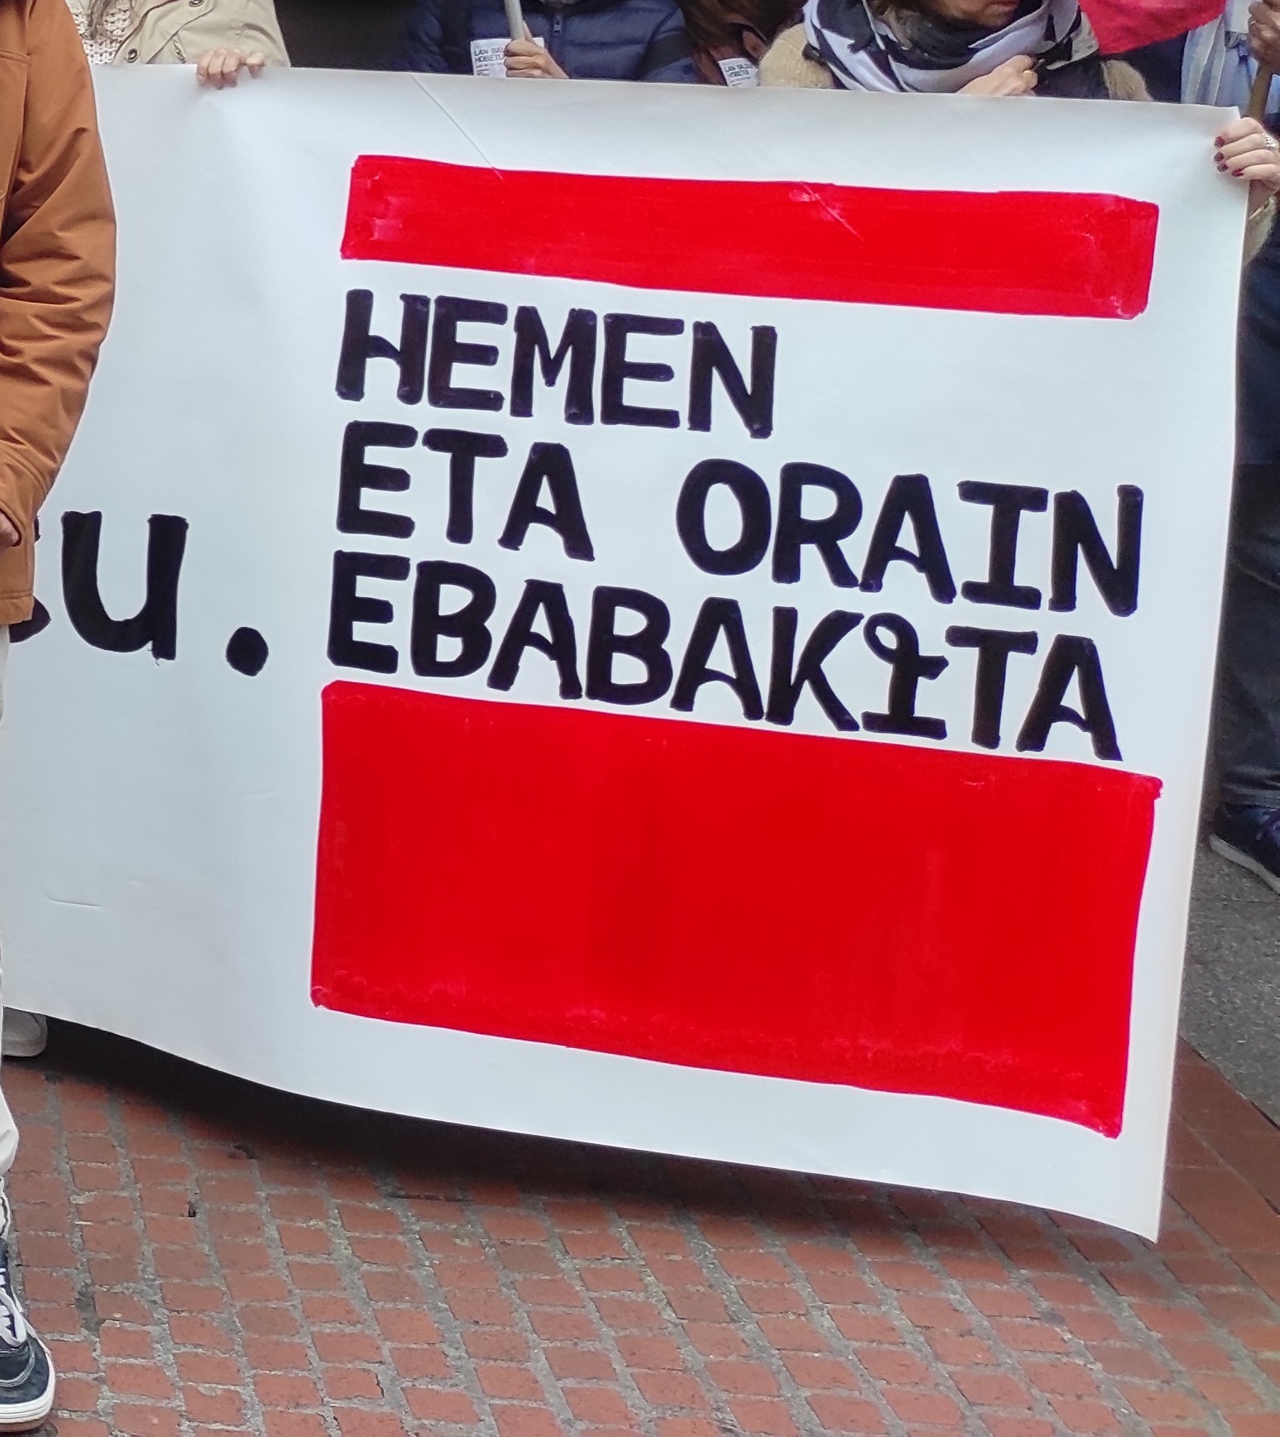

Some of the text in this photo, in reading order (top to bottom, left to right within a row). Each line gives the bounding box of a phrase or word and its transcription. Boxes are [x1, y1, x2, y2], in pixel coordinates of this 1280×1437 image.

[335, 288, 778, 439] HEMEN
[336, 420, 1144, 616] ETA ORAIN
